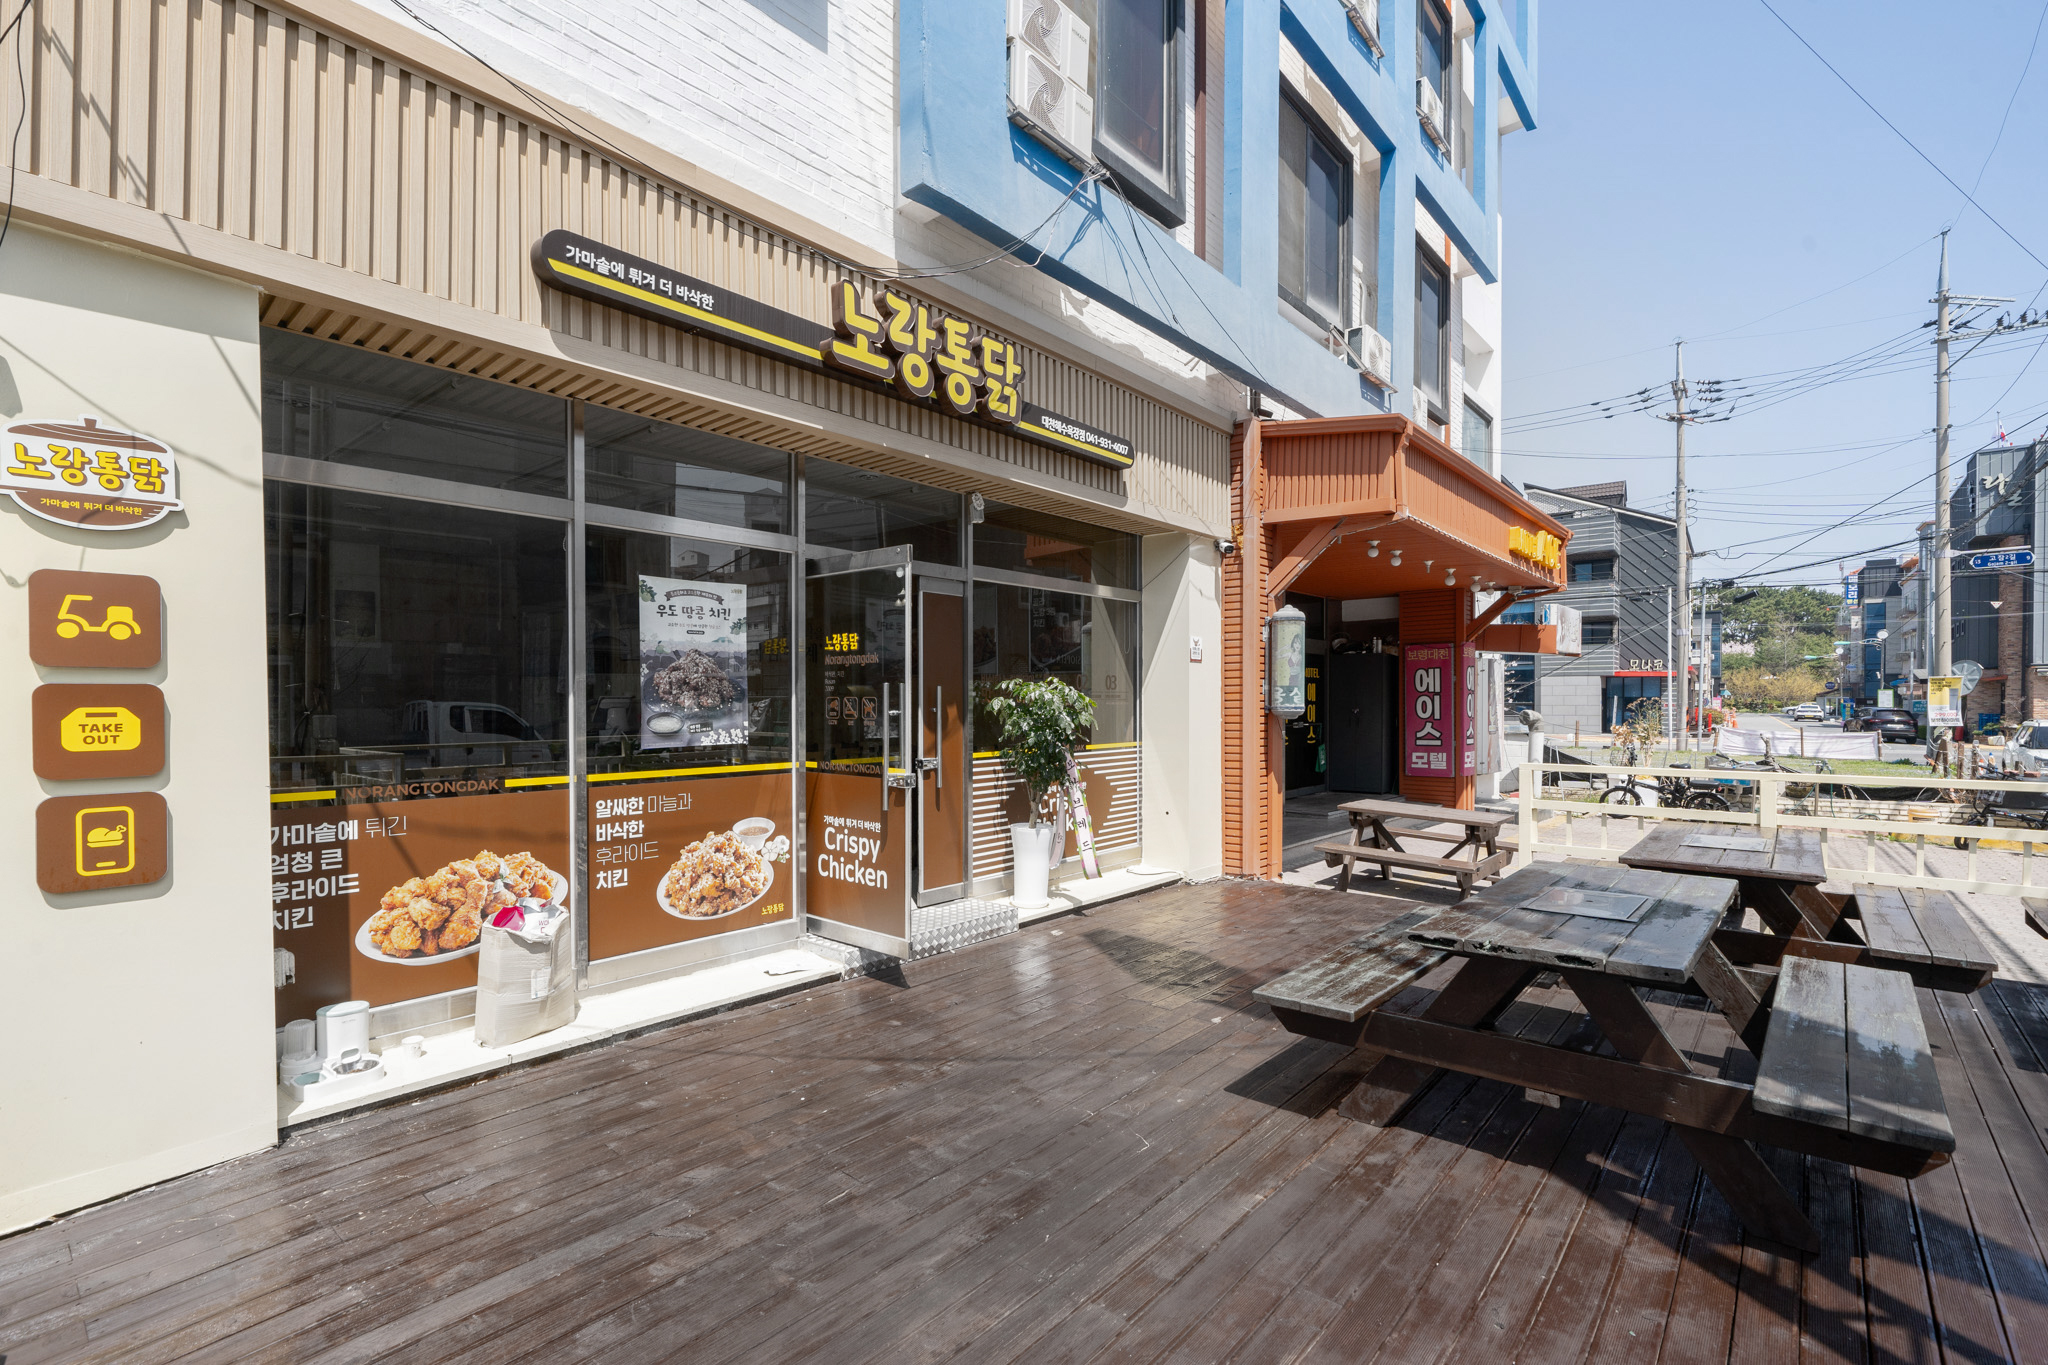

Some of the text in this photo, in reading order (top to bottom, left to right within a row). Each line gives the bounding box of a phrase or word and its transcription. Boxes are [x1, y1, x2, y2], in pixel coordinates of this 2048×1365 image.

[566, 244, 715, 312] 가마솥에 튀겨 더 바삭한
[828, 281, 1025, 421] 노랑통닭
[1041, 415, 1129, 455] 대천해수욕장점 041-931-4007
[7, 442, 168, 494] 노랑통닭
[40, 497, 143, 516] 가마솥에 튀겨 더 바삭한
[656, 604, 731, 621] 우도 땅콩 치킨
[824, 632, 859, 651] 노랑통닭
[824, 651, 879, 668] Norangtongdak
[1408, 648, 1449, 661] 보령대천
[1629, 658, 1664, 671] 모나코
[1105, 674, 1118, 691] 03
[1307, 683, 1316, 744] 에이스
[1414, 667, 1443, 747] 에이스
[78, 723, 124, 734] TAKE
[82, 734, 121, 745] OUT
[820, 760, 883, 775] NORANGTONGDA
[1411, 752, 1447, 769] 모텔
[343, 778, 500, 800] NORANGTONGDAK
[595, 792, 693, 819] 알싸한 마늘과
[271, 815, 407, 847] 가마솥에 튀긴
[595, 819, 645, 842] 바삭한
[823, 814, 845, 827] 가마솥에
[857, 818, 864, 830] 더
[863, 819, 881, 833] 바삭한
[595, 841, 659, 866] 후라이드
[823, 826, 881, 864] Crispy
[272, 847, 343, 876] 엄청 큰
[817, 855, 888, 890] Chicken
[272, 873, 360, 904] 후라이드
[596, 867, 629, 890] 치킨
[273, 906, 314, 931] 치킨
